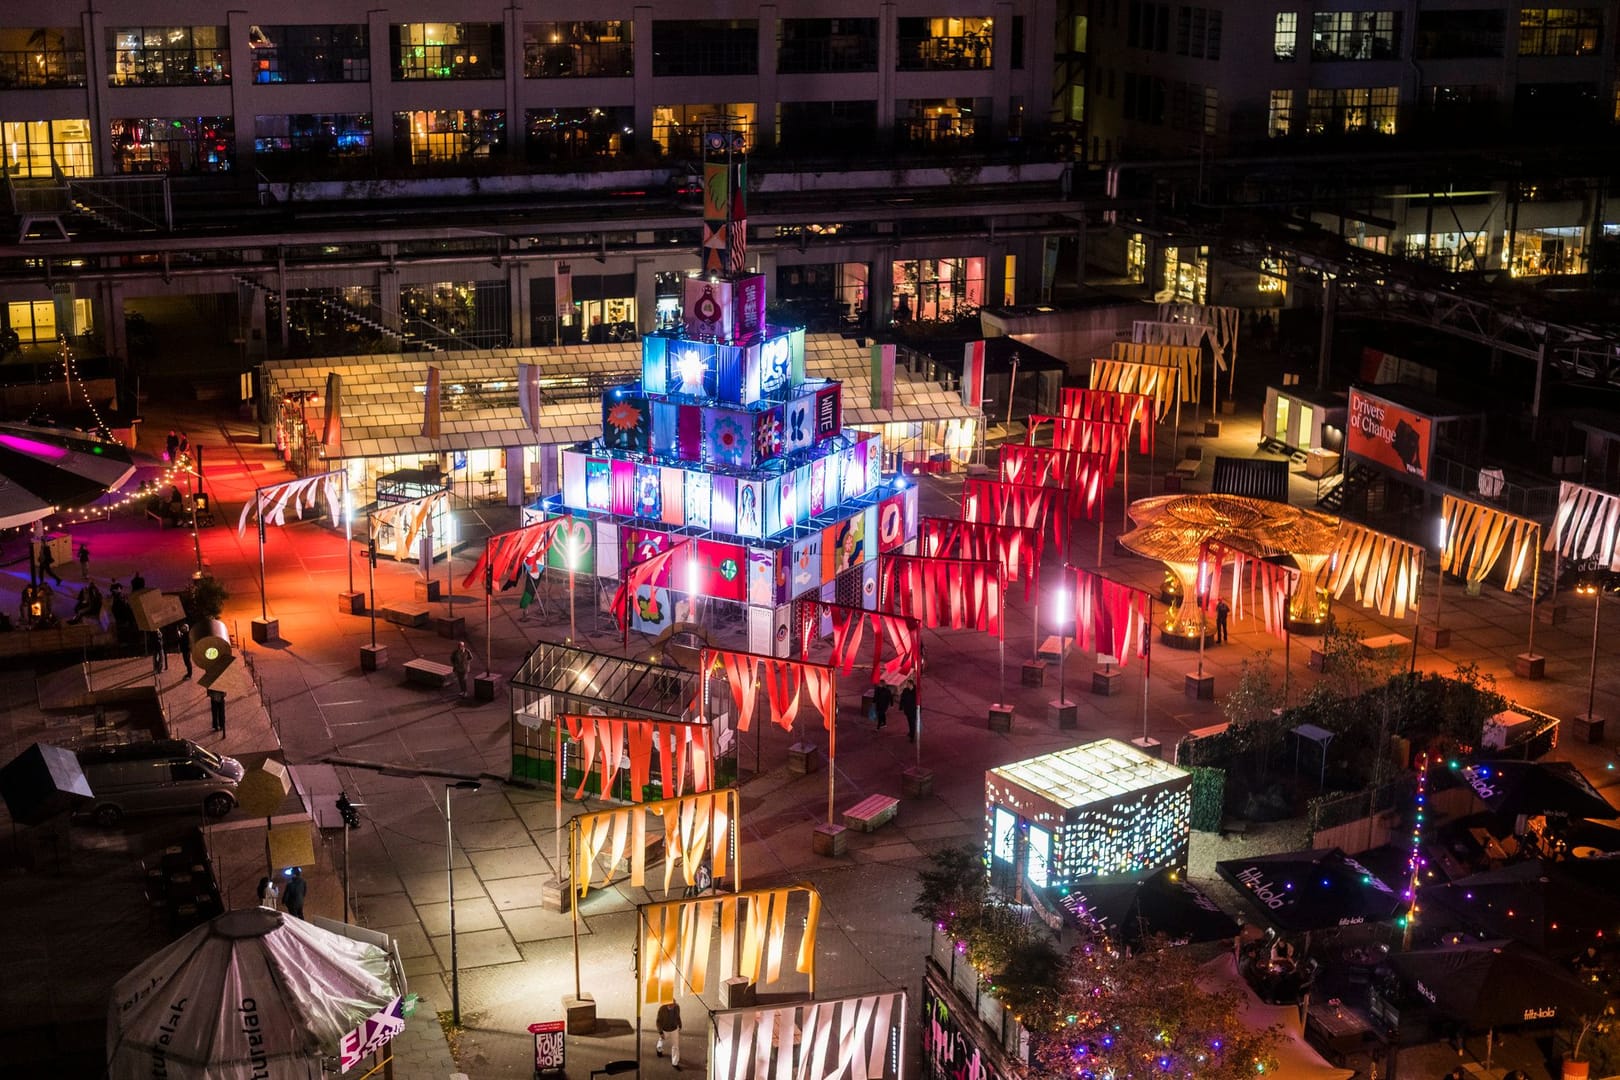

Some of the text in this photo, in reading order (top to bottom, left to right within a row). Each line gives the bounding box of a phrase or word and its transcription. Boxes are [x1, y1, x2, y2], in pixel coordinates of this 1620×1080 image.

[821, 394, 834, 431] WHITE
[1353, 396, 1385, 421] Drivers
[1351, 413, 1397, 443] of Change
[1235, 867, 1285, 910] fritz-kola
[340, 994, 404, 1058] FIX
